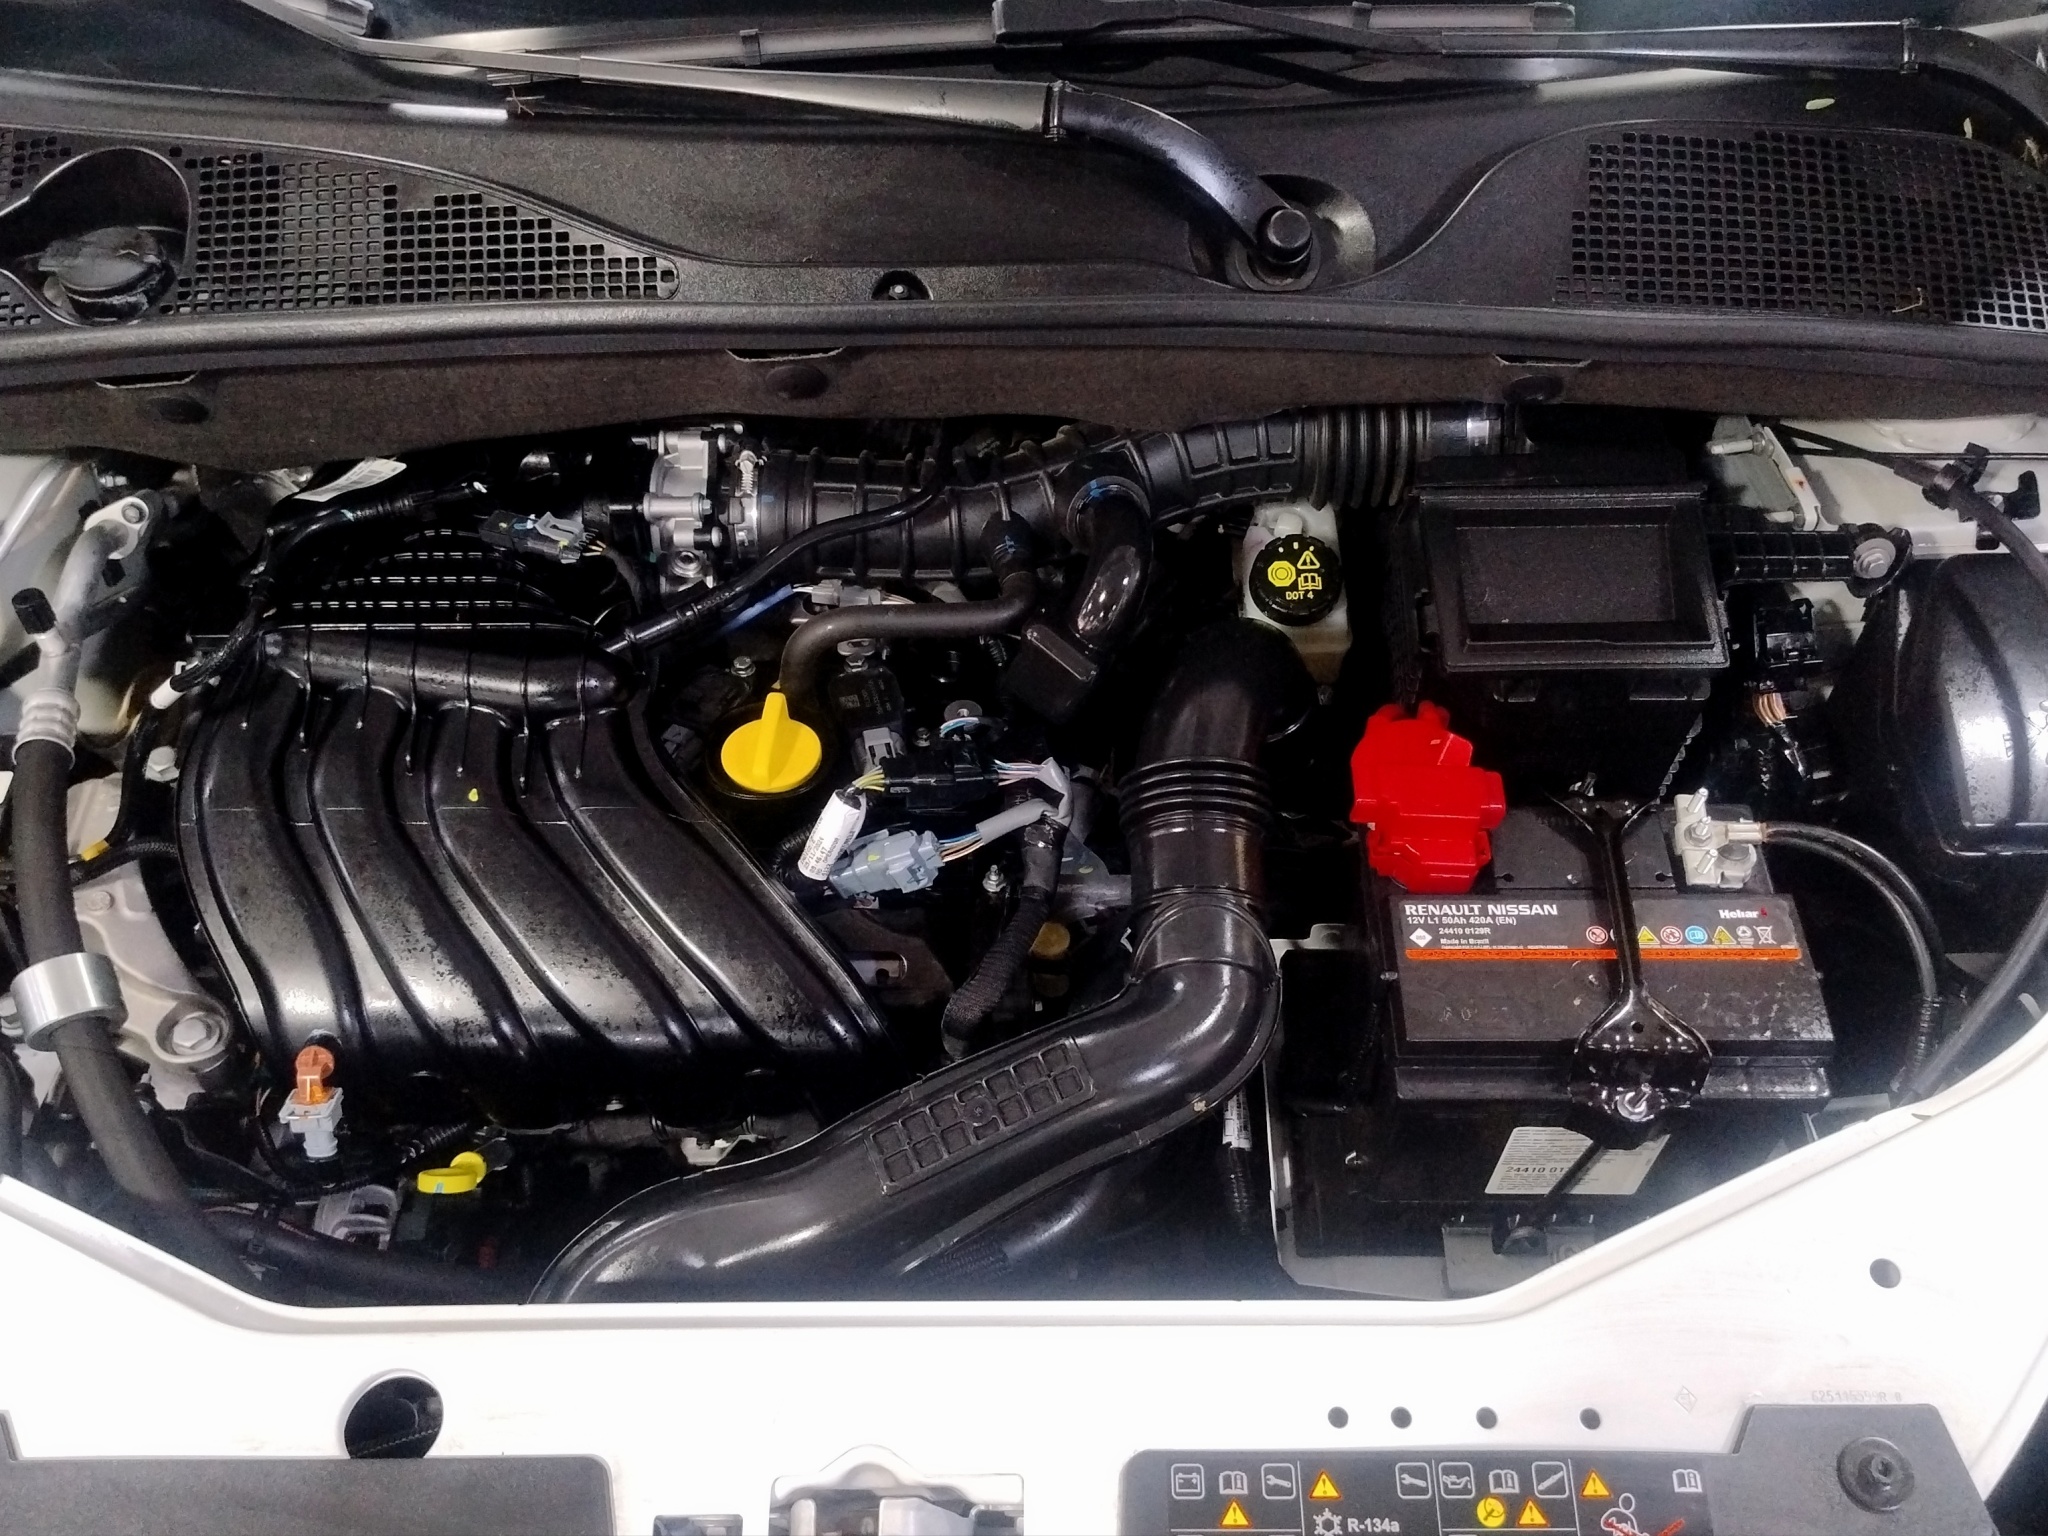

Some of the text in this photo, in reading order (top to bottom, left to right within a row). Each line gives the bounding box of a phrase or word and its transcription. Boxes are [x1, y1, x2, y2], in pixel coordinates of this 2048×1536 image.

[1286, 591, 1314, 600] DOT 4
[1404, 904, 1559, 916] RENAULT NISSAN
[1407, 916, 1517, 926] 12V L1 50Ah 420A (EN)
[1347, 1517, 1400, 1533] R-134a
